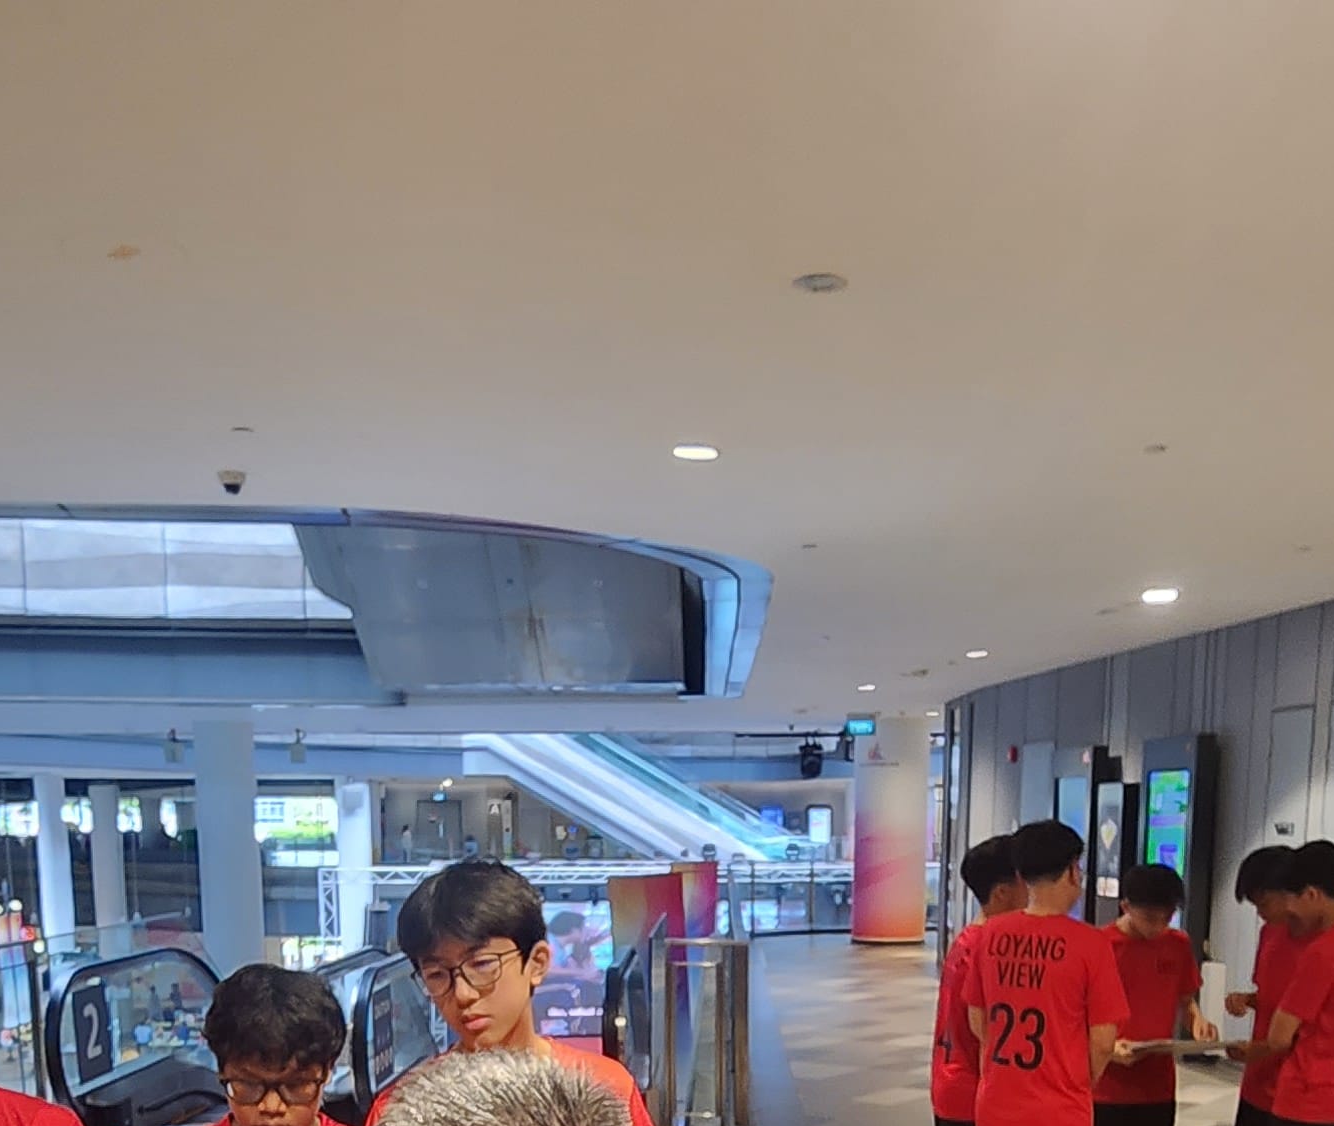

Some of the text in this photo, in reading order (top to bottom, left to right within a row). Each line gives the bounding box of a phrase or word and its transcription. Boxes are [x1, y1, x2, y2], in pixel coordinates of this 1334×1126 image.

[987, 933, 1067, 960] LOYANG
[997, 960, 1046, 989] VIEW
[82, 1002, 102, 1060] 2
[989, 1002, 1046, 1070] 23
